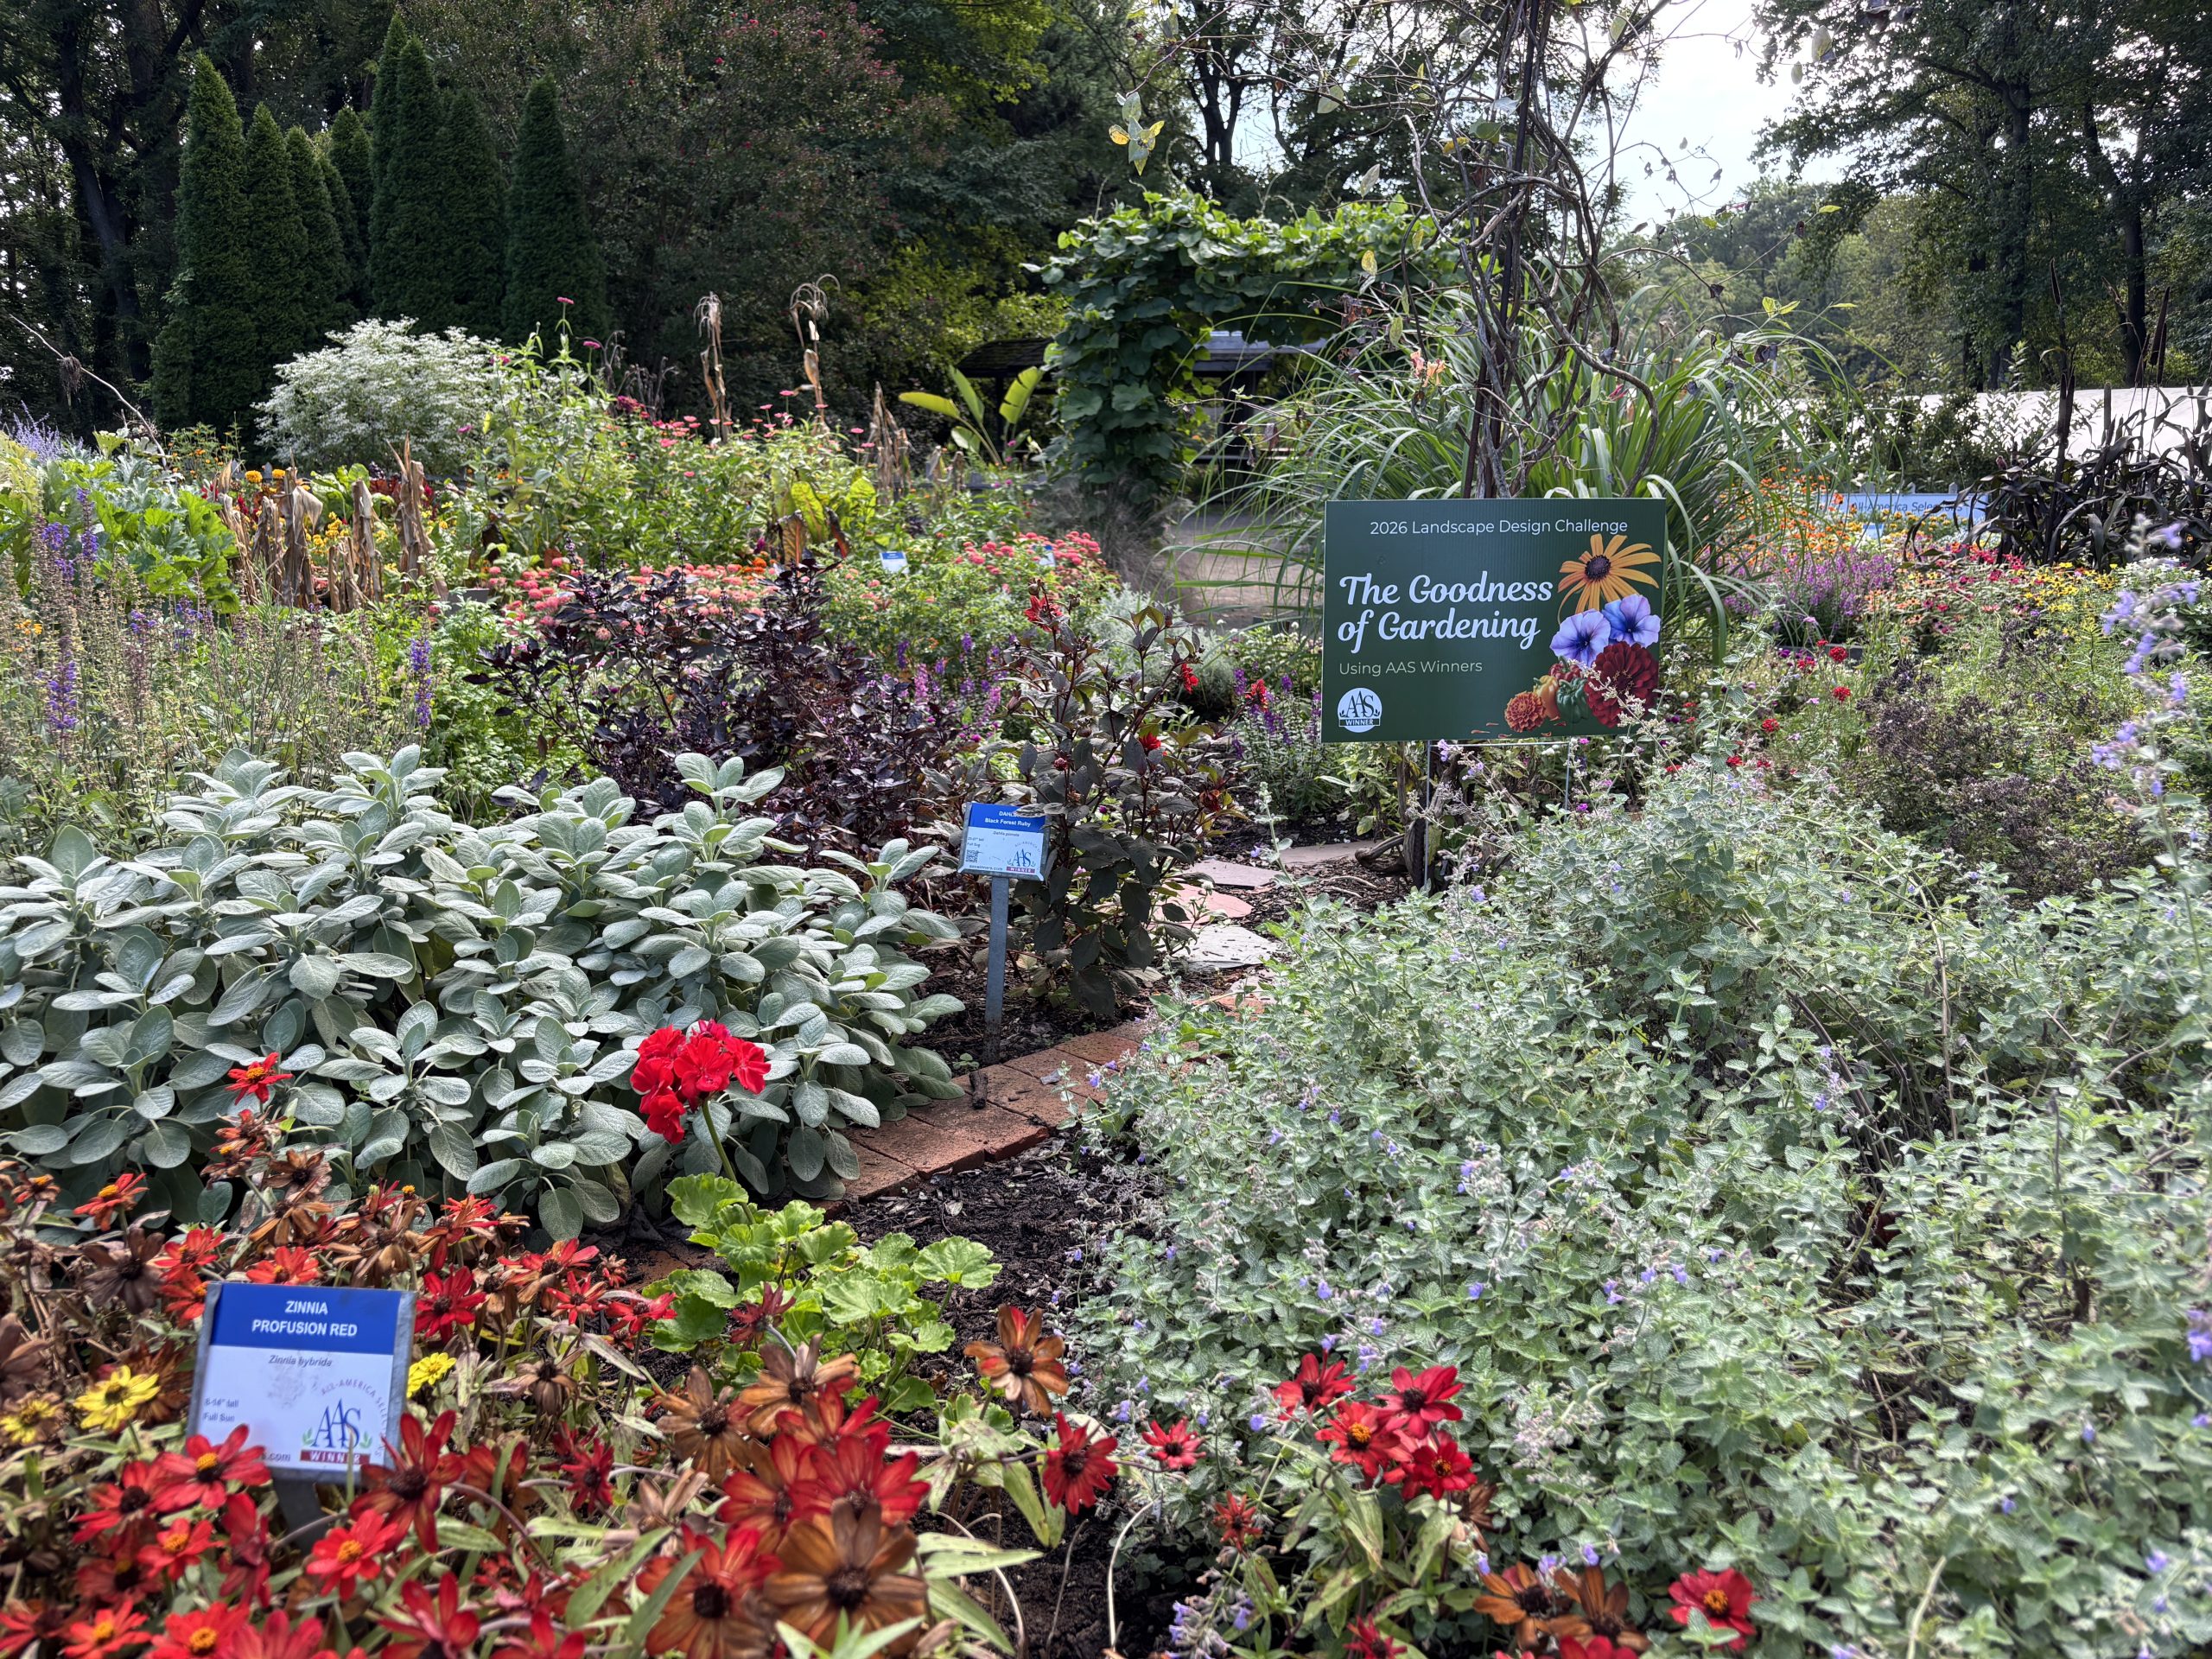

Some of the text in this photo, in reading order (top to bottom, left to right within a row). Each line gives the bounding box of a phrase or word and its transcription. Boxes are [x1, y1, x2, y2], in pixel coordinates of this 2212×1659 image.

[1912, 502, 1962, 512] Seleos
[1370, 518, 1628, 537] 2026 Landscape Design Challenge
[1339, 570, 1553, 605] The Goodness
[1338, 607, 1541, 654] of Gardening
[1339, 660, 1483, 677] Using AAS Winners
[1344, 690, 1375, 718] AAS
[1012, 848, 1032, 868] AAS
[285, 1300, 328, 1315] ZINNIA
[251, 1319, 358, 1337] PROFUSION RED
[268, 1355, 333, 1368] Zinnia hybrida
[203, 1412, 235, 1422] Full Sun
[311, 1398, 361, 1449] AAS
[310, 1450, 360, 1465] WINNR
